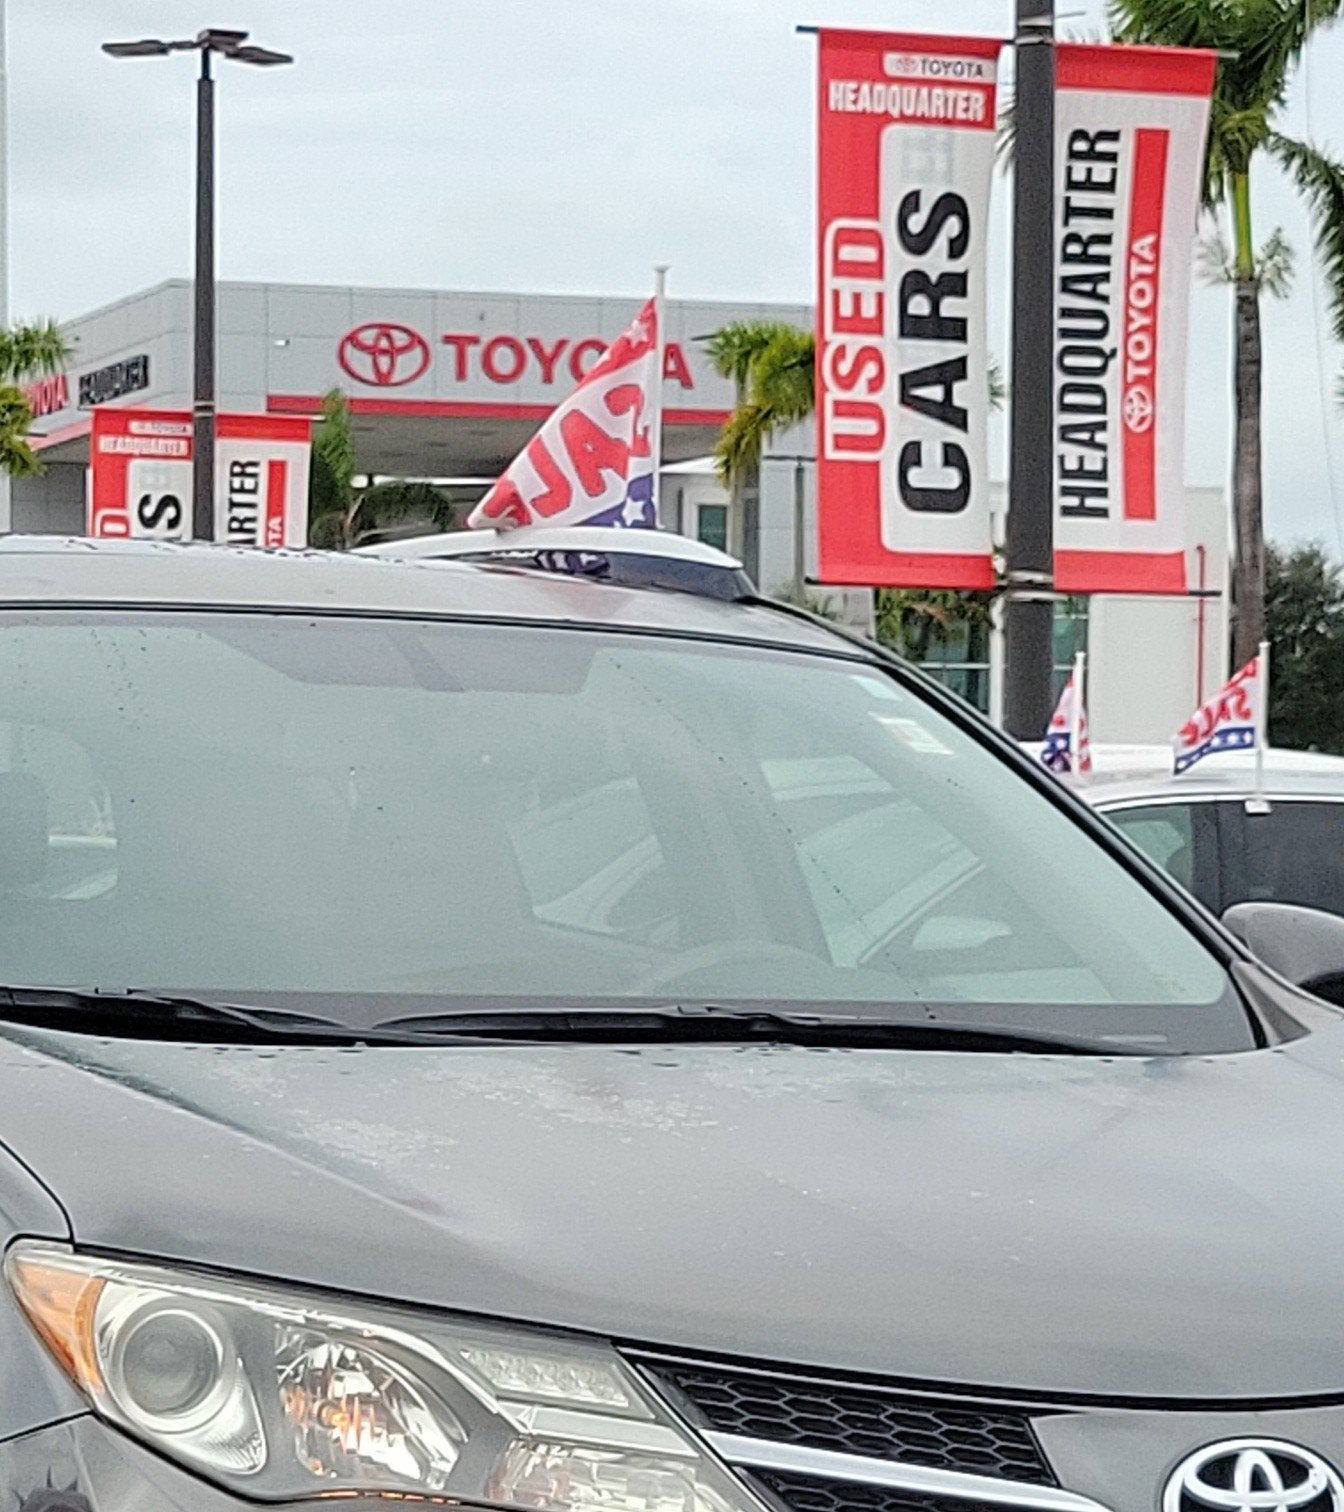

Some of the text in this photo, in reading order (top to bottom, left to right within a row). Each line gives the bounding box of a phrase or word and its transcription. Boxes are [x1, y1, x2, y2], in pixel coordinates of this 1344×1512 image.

[828, 80, 986, 122] HEADQUARTER
[920, 58, 984, 78] TOYOTA
[442, 335, 694, 390] TOYOA
[825, 217, 886, 461] USED
[898, 189, 971, 514] CARS
[1058, 128, 1121, 519] HEADQUARTER
[1125, 235, 1157, 383] TOYOTA
